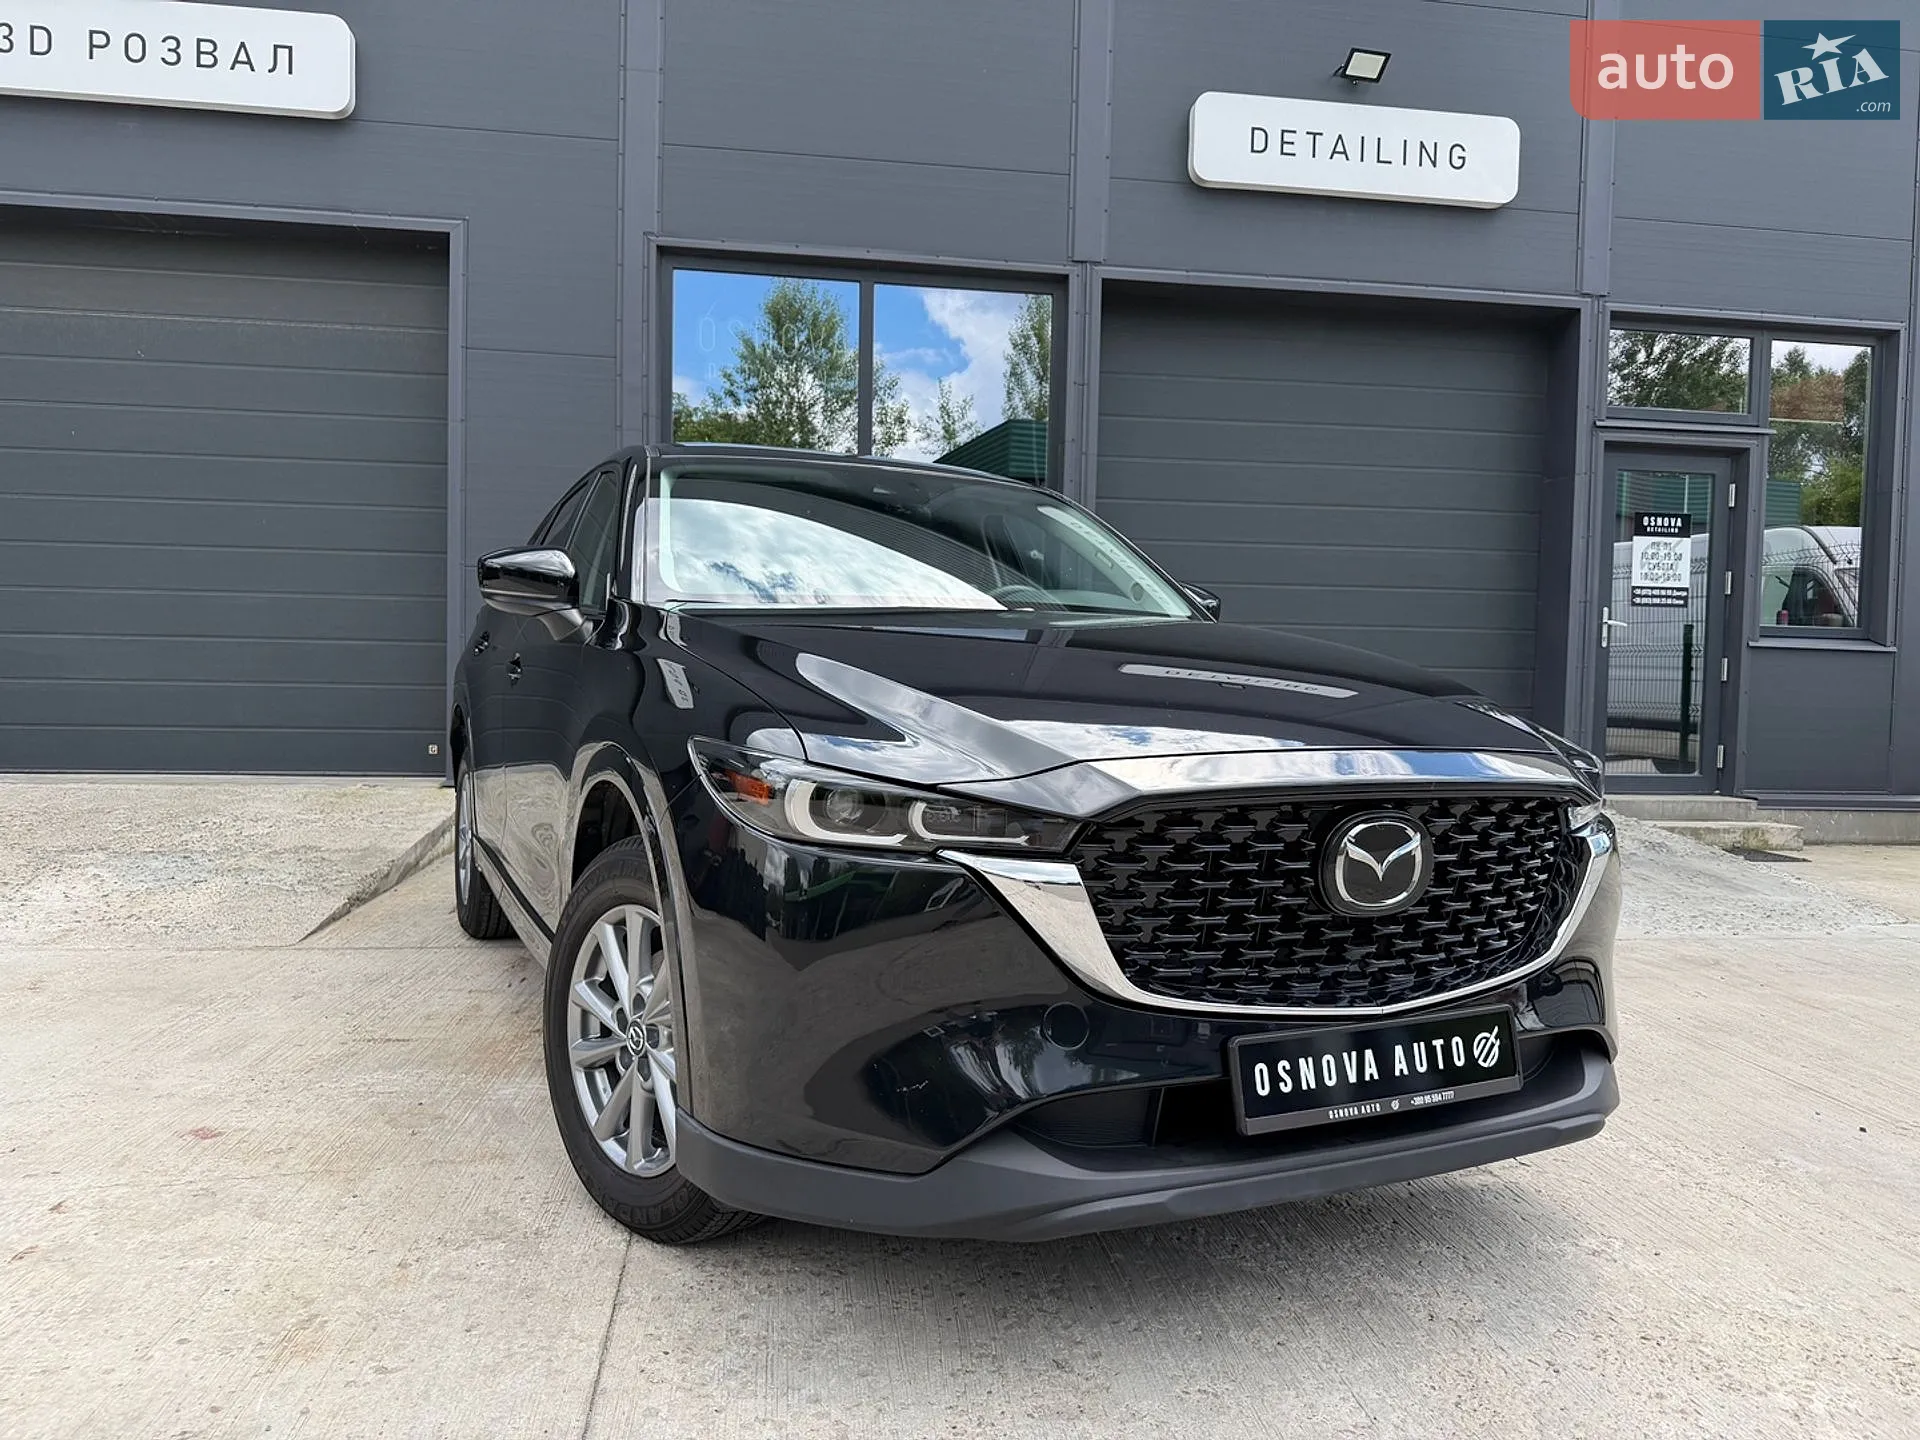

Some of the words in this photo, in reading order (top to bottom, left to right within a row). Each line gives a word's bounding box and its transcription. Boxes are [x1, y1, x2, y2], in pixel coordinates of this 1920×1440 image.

[0, 22, 53, 56] 3D
[88, 29, 294, 75] РОЗВАЛ
[1250, 126, 1467, 170] DETAILING
[1643, 515, 1682, 527] OSNOVA
[1254, 1048, 1380, 1097] OSNOVA
[1394, 1035, 1466, 1077] AUTO
[1328, 1106, 1359, 1119] OSNOVA
[1361, 1102, 1381, 1115] AUTO
